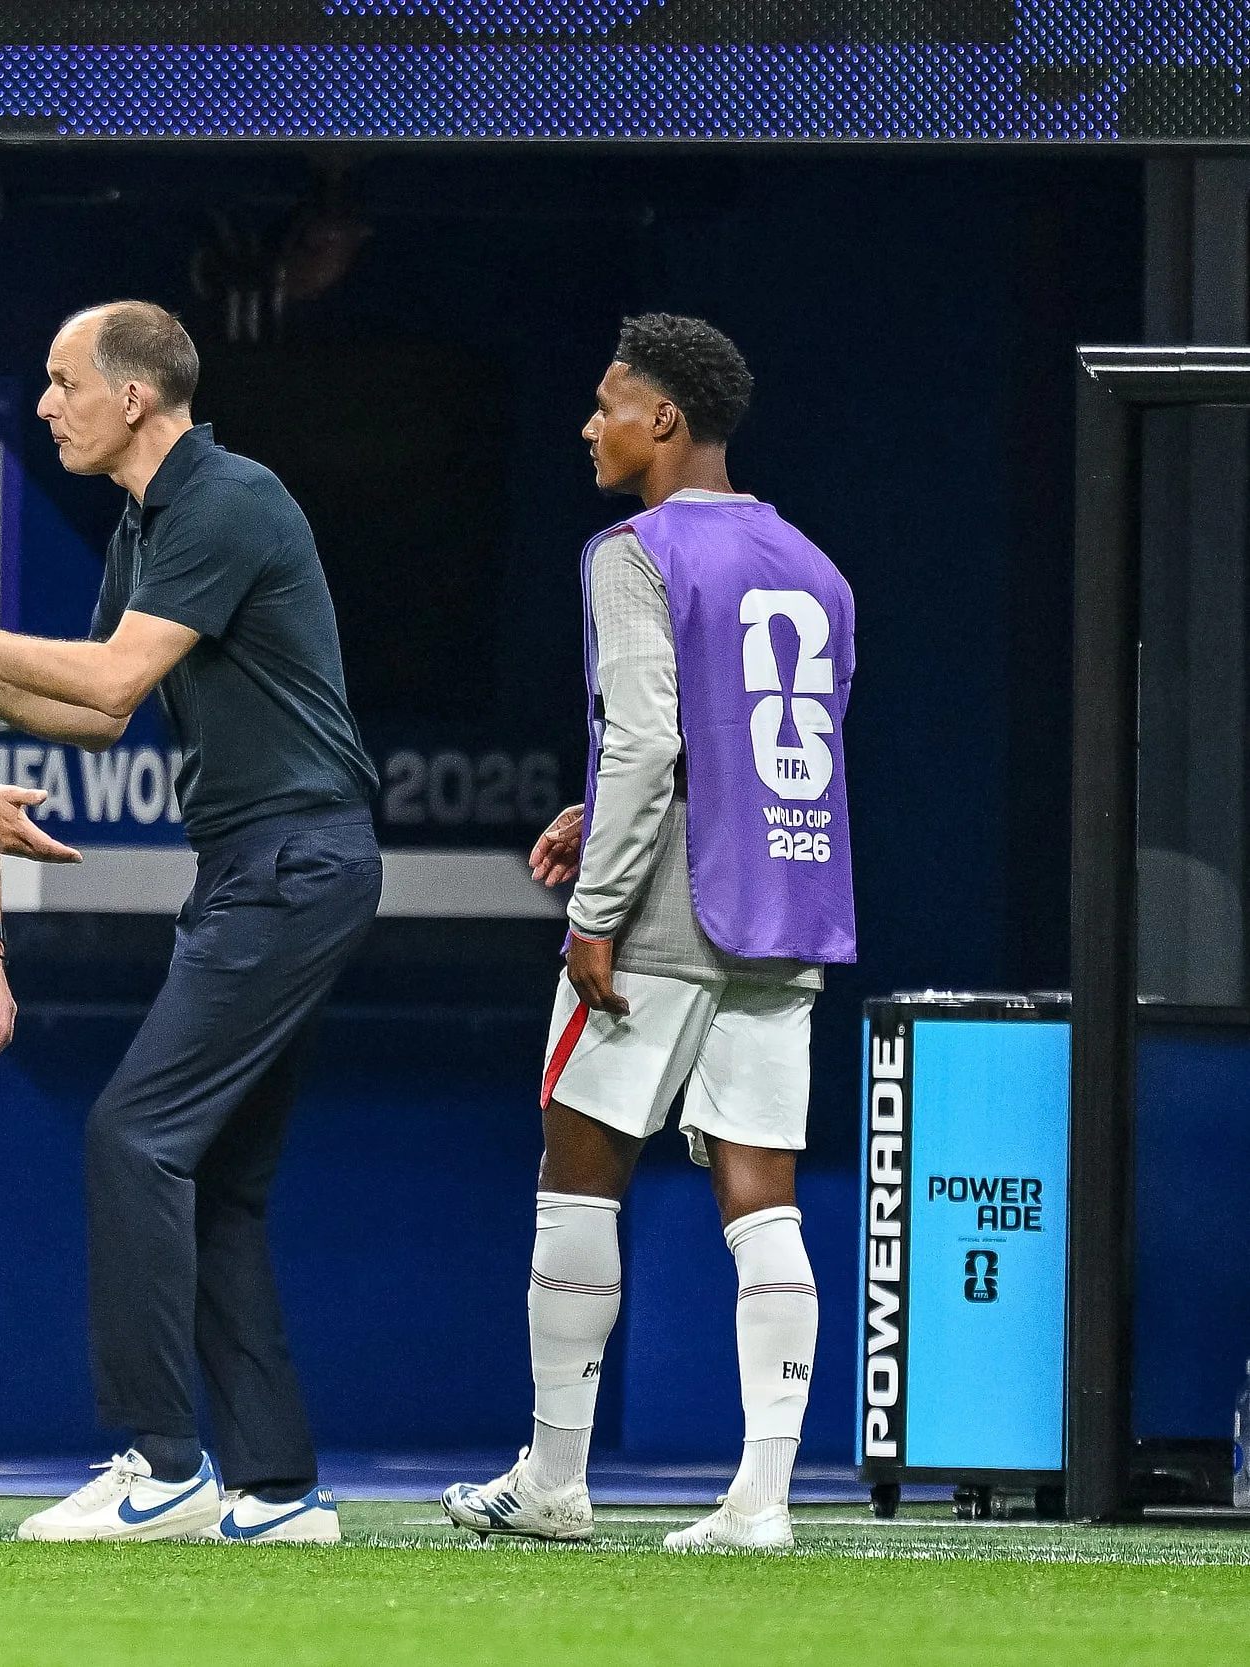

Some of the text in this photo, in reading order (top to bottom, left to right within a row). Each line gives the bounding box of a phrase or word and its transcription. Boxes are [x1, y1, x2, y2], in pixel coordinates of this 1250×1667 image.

[776, 758, 810, 780] FIFA
[79, 748, 184, 824] WO
[383, 751, 560, 824] 2026
[806, 810, 832, 828] CUP
[928, 1176, 1043, 1204] POWER
[977, 1205, 1043, 1232] ADE
[782, 1360, 810, 1381] ENG
[317, 1490, 334, 1503] NIK
